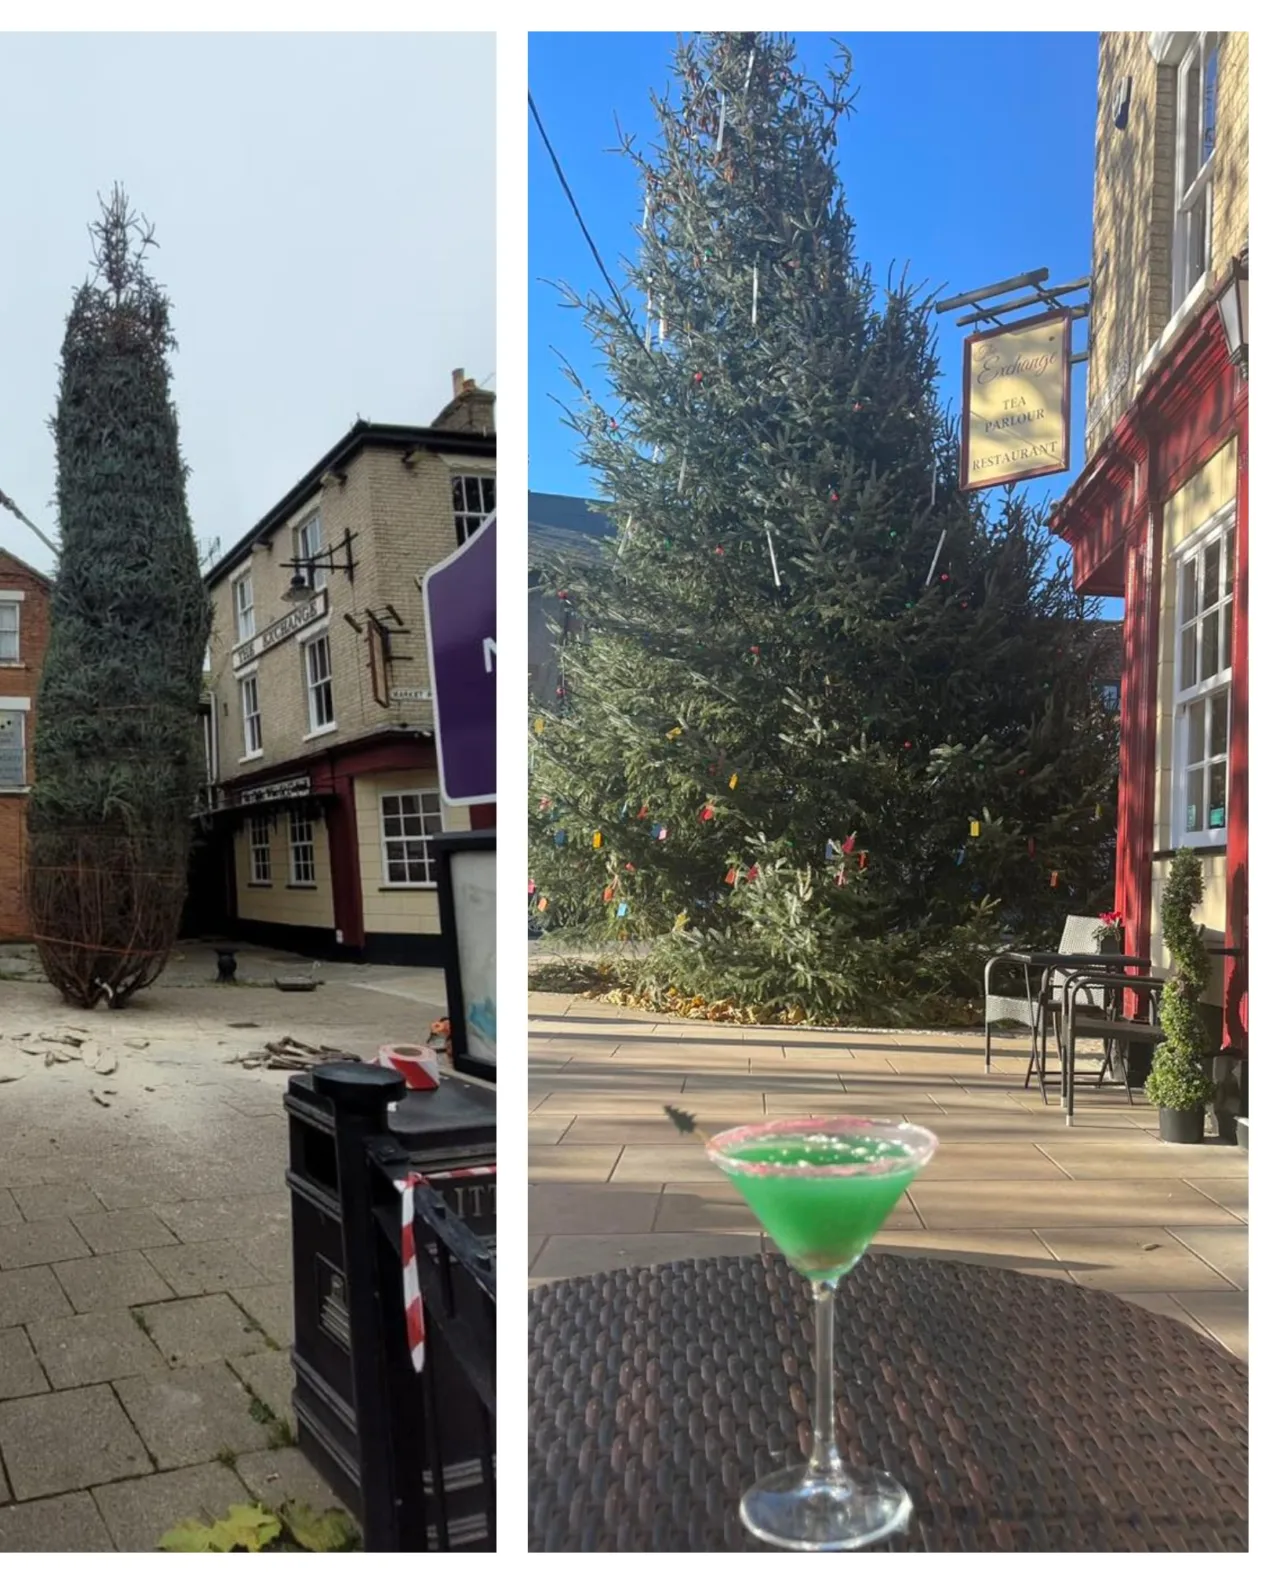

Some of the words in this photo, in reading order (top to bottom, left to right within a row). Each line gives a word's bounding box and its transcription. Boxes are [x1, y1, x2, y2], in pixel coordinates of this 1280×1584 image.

[977, 351, 1058, 385] Exchange
[1003, 396, 1027, 411] TEA
[984, 408, 1045, 433] PARLOUR
[972, 441, 1058, 471] RESTAURANT
[238, 641, 256, 664] THE
[262, 599, 318, 649] EXCHANGE
